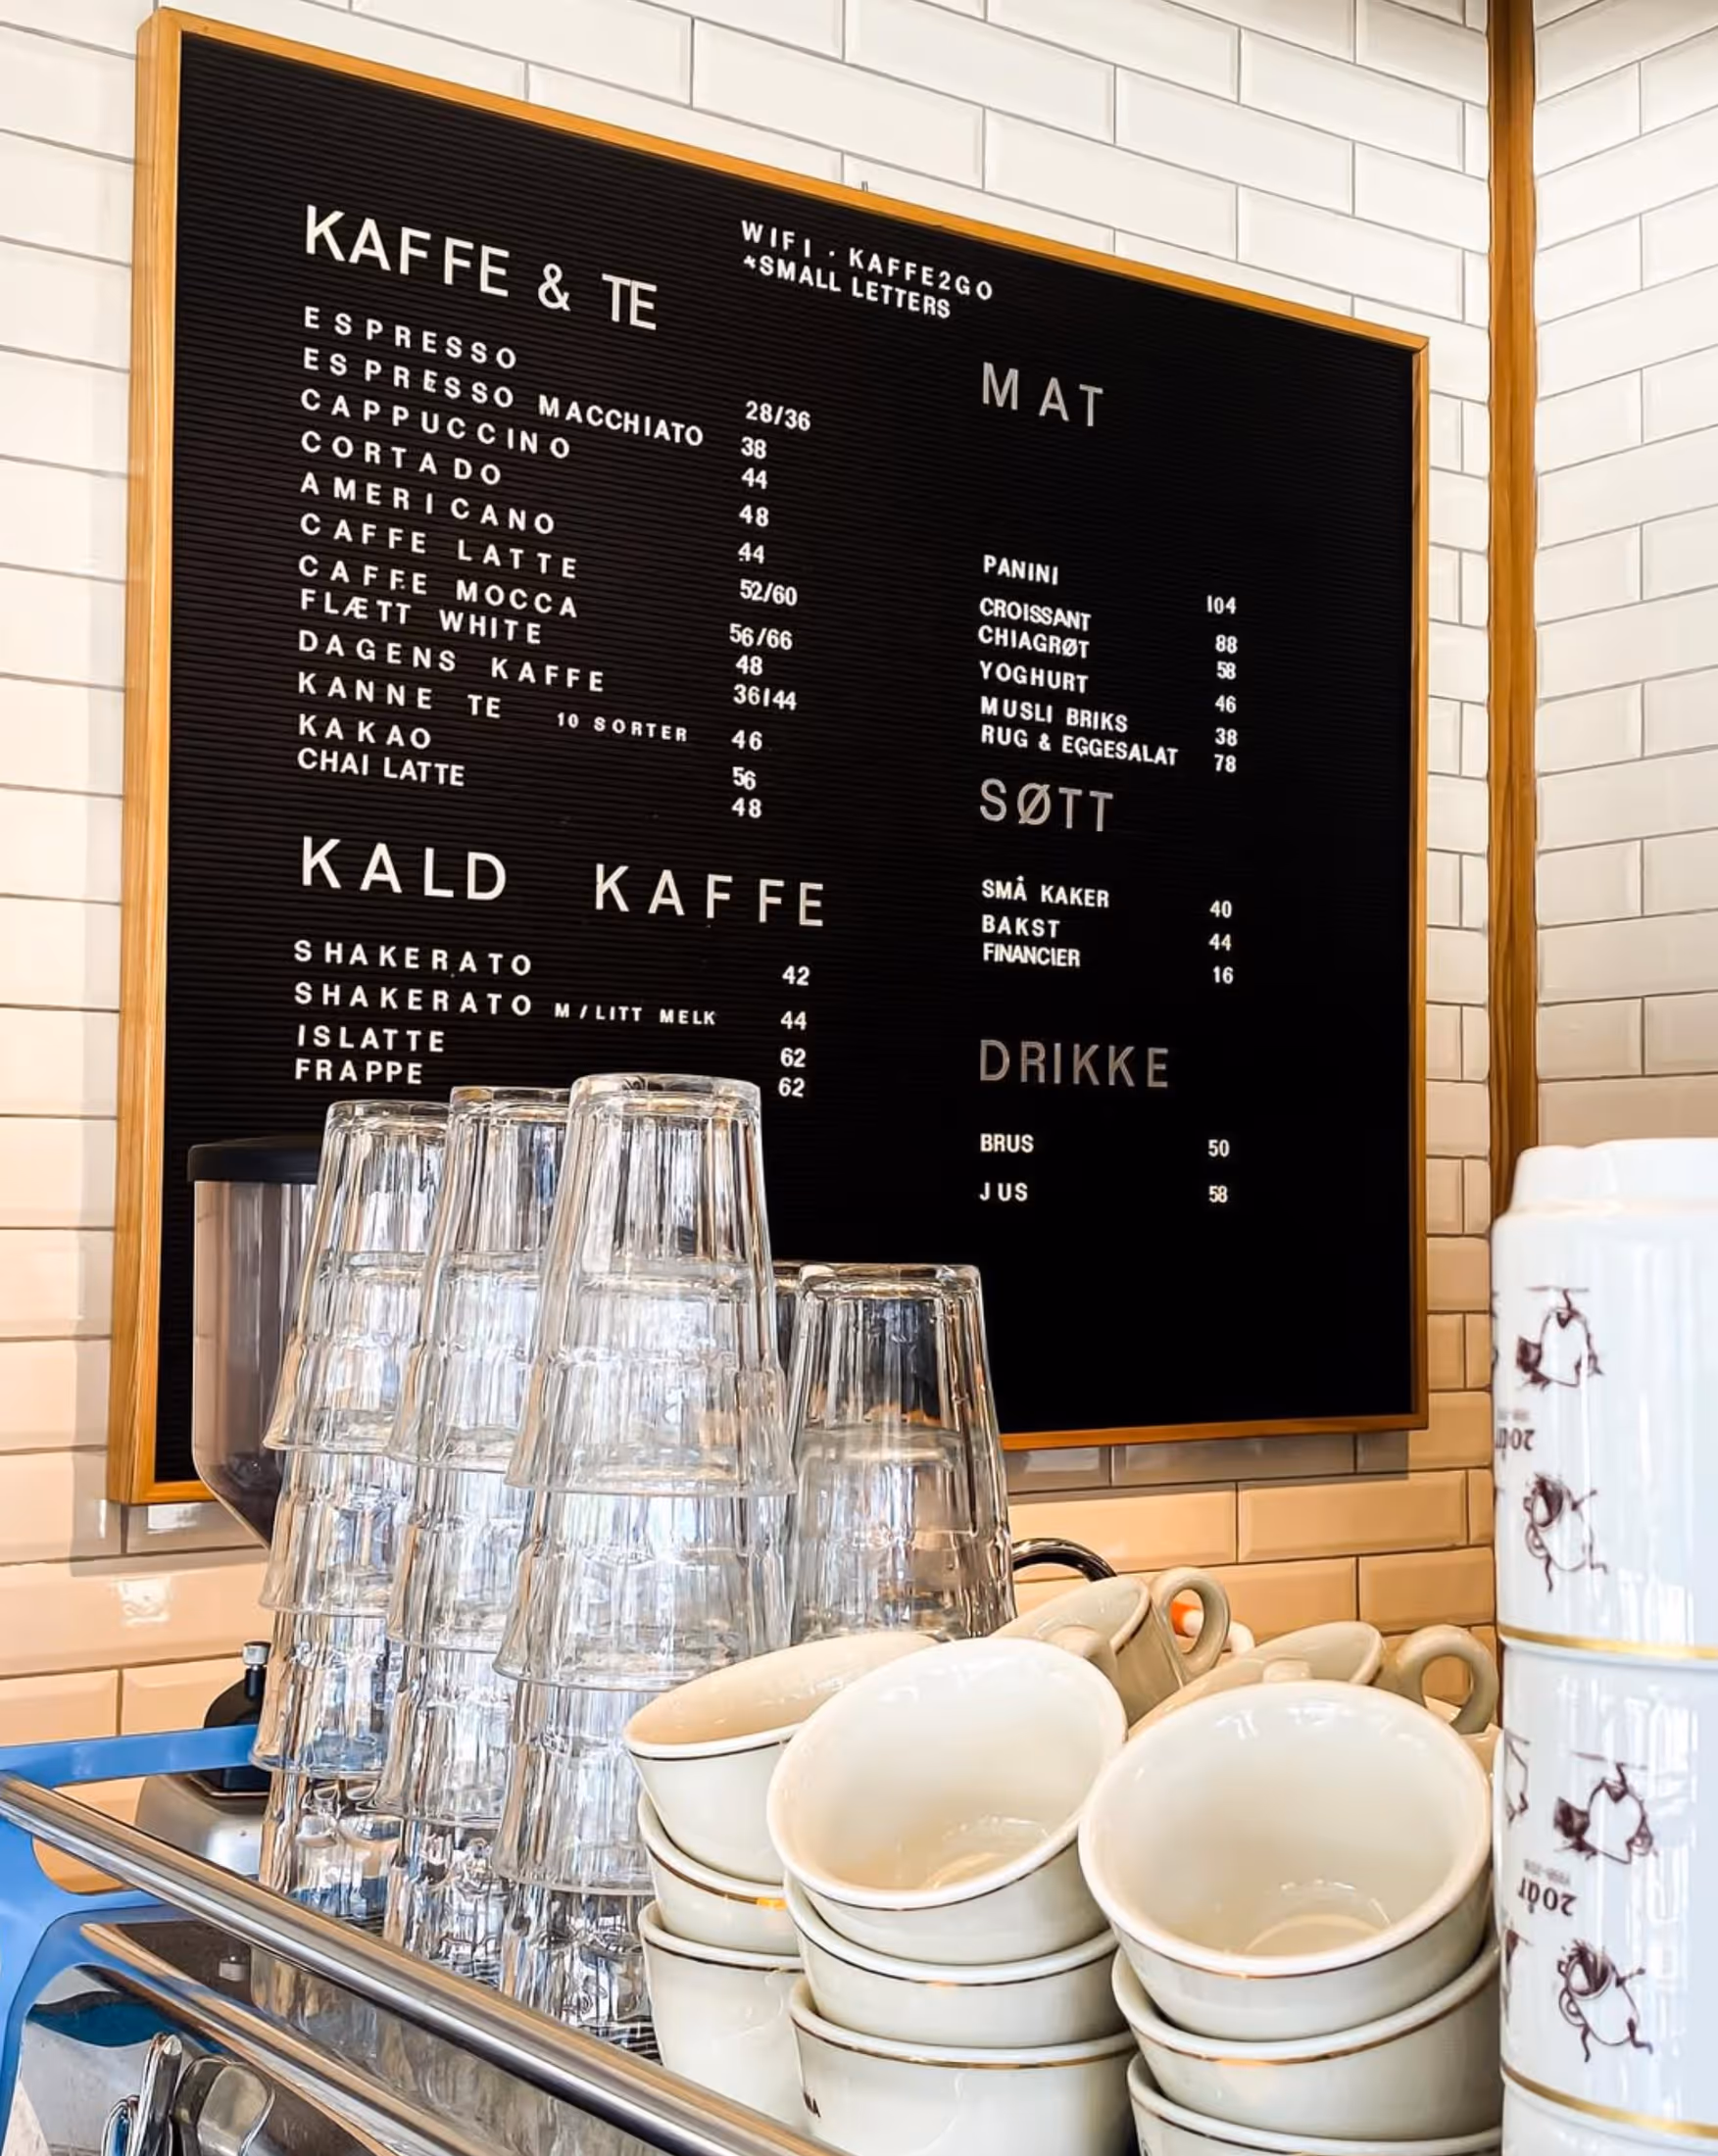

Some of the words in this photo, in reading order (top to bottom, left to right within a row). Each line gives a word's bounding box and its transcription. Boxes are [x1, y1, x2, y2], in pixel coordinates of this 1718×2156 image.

[307, 205, 509, 297] KAFFE
[538, 264, 570, 311] &
[602, 273, 657, 330] TE
[742, 220, 810, 258] WIFI
[850, 248, 992, 301] KAFFE2GO
[853, 276, 950, 318] LETTERS
[304, 306, 515, 370] ESPRESSO
[303, 347, 514, 408] ESPRESSO
[539, 395, 703, 446] MACCHIATO
[983, 362, 1103, 426] MAT
[301, 386, 569, 464] CAPPUCCINO
[746, 401, 810, 431] 28/36
[302, 431, 500, 485] CORTADO
[741, 437, 766, 459] 38
[742, 467, 767, 489] 44
[301, 472, 554, 535] AMERICANO
[739, 505, 768, 527] 48
[301, 514, 425, 554] CAFFE
[459, 539, 576, 578] LATTE
[738, 542, 764, 564] 44
[984, 555, 1057, 585] PANINI
[299, 555, 426, 595] CAFFE
[457, 580, 576, 617] MOCCA
[740, 579, 797, 606] 52/60
[302, 588, 411, 624] FLÆTT
[439, 610, 540, 644] WHITE
[980, 598, 1091, 631] CROISSANT
[730, 623, 792, 650] 56/66
[978, 625, 1089, 659] CHIAGRØT
[1216, 635, 1237, 654] 88
[299, 630, 455, 671] DAGENS
[492, 658, 603, 692] KAFFE
[736, 655, 762, 675] 48
[1217, 662, 1236, 679] 58
[980, 661, 1088, 693] YOGHURT
[299, 671, 431, 710] KANNE
[467, 695, 500, 718] TE
[558, 712, 578, 728] 10
[594, 716, 686, 741] SORTER
[981, 696, 1052, 723] MUSLI
[1067, 708, 1127, 732] BRIKS
[1215, 696, 1236, 712] 46
[300, 713, 430, 749] KAKAO
[732, 730, 761, 751] 46
[1215, 728, 1237, 746] 38
[982, 725, 1027, 747] RUG
[1039, 733, 1051, 751] &
[1062, 735, 1178, 765] EGGESALAT
[298, 748, 368, 775] CHAI
[384, 757, 465, 786] LATTE
[1215, 754, 1236, 772] 78
[733, 766, 756, 790] 56
[732, 798, 761, 818] 48
[980, 779, 1112, 831] SØTT
[303, 836, 506, 900] KALD
[596, 863, 823, 926] KAFFE
[982, 876, 1027, 901] SMÅ
[1042, 885, 1108, 907] KAKER
[1210, 901, 1232, 917] 40
[982, 914, 1059, 938] BAKST
[984, 943, 1080, 966] FINANCIER
[1209, 934, 1231, 951] 44
[294, 940, 530, 975] SHAKERATO
[782, 965, 810, 986] 42
[1214, 966, 1233, 984] 16
[295, 982, 530, 1015] SHAKERATO
[661, 1009, 714, 1025] MELK
[781, 1011, 807, 1030] 44
[298, 1025, 444, 1052] ISLATTE
[296, 1058, 421, 1084] FRAPPE
[781, 1048, 806, 1067] 62
[980, 1040, 1168, 1087] DRIKKE
[779, 1077, 805, 1097] 62
[981, 1134, 1033, 1152] BRUS
[1208, 1140, 1229, 1156] 50
[980, 1183, 1027, 1201] JUS
[1209, 1186, 1227, 1202] 58
